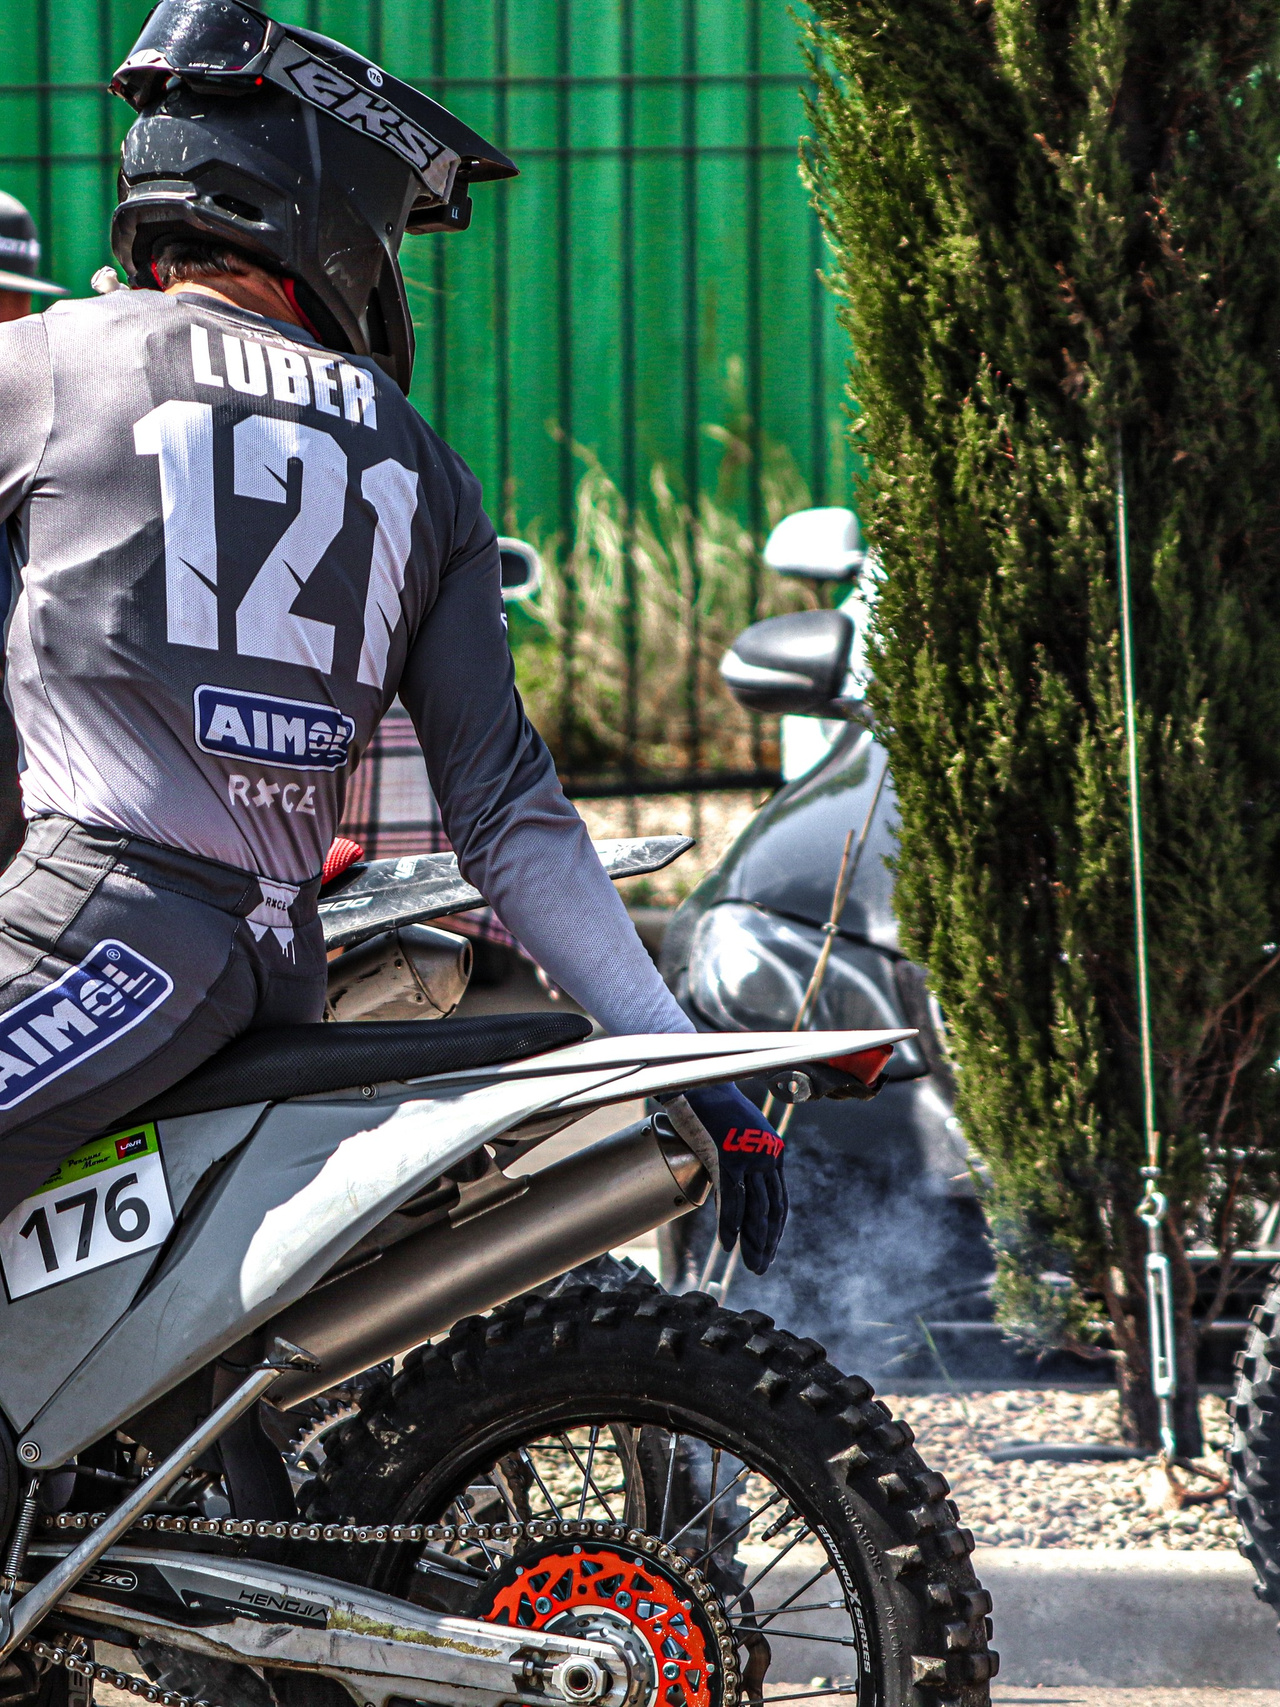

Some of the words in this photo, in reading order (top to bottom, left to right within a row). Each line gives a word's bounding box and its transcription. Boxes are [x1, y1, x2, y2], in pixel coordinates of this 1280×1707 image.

[190, 322, 378, 431] LUBER
[132, 399, 419, 690] 121
[19, 1172, 151, 1273] 176
